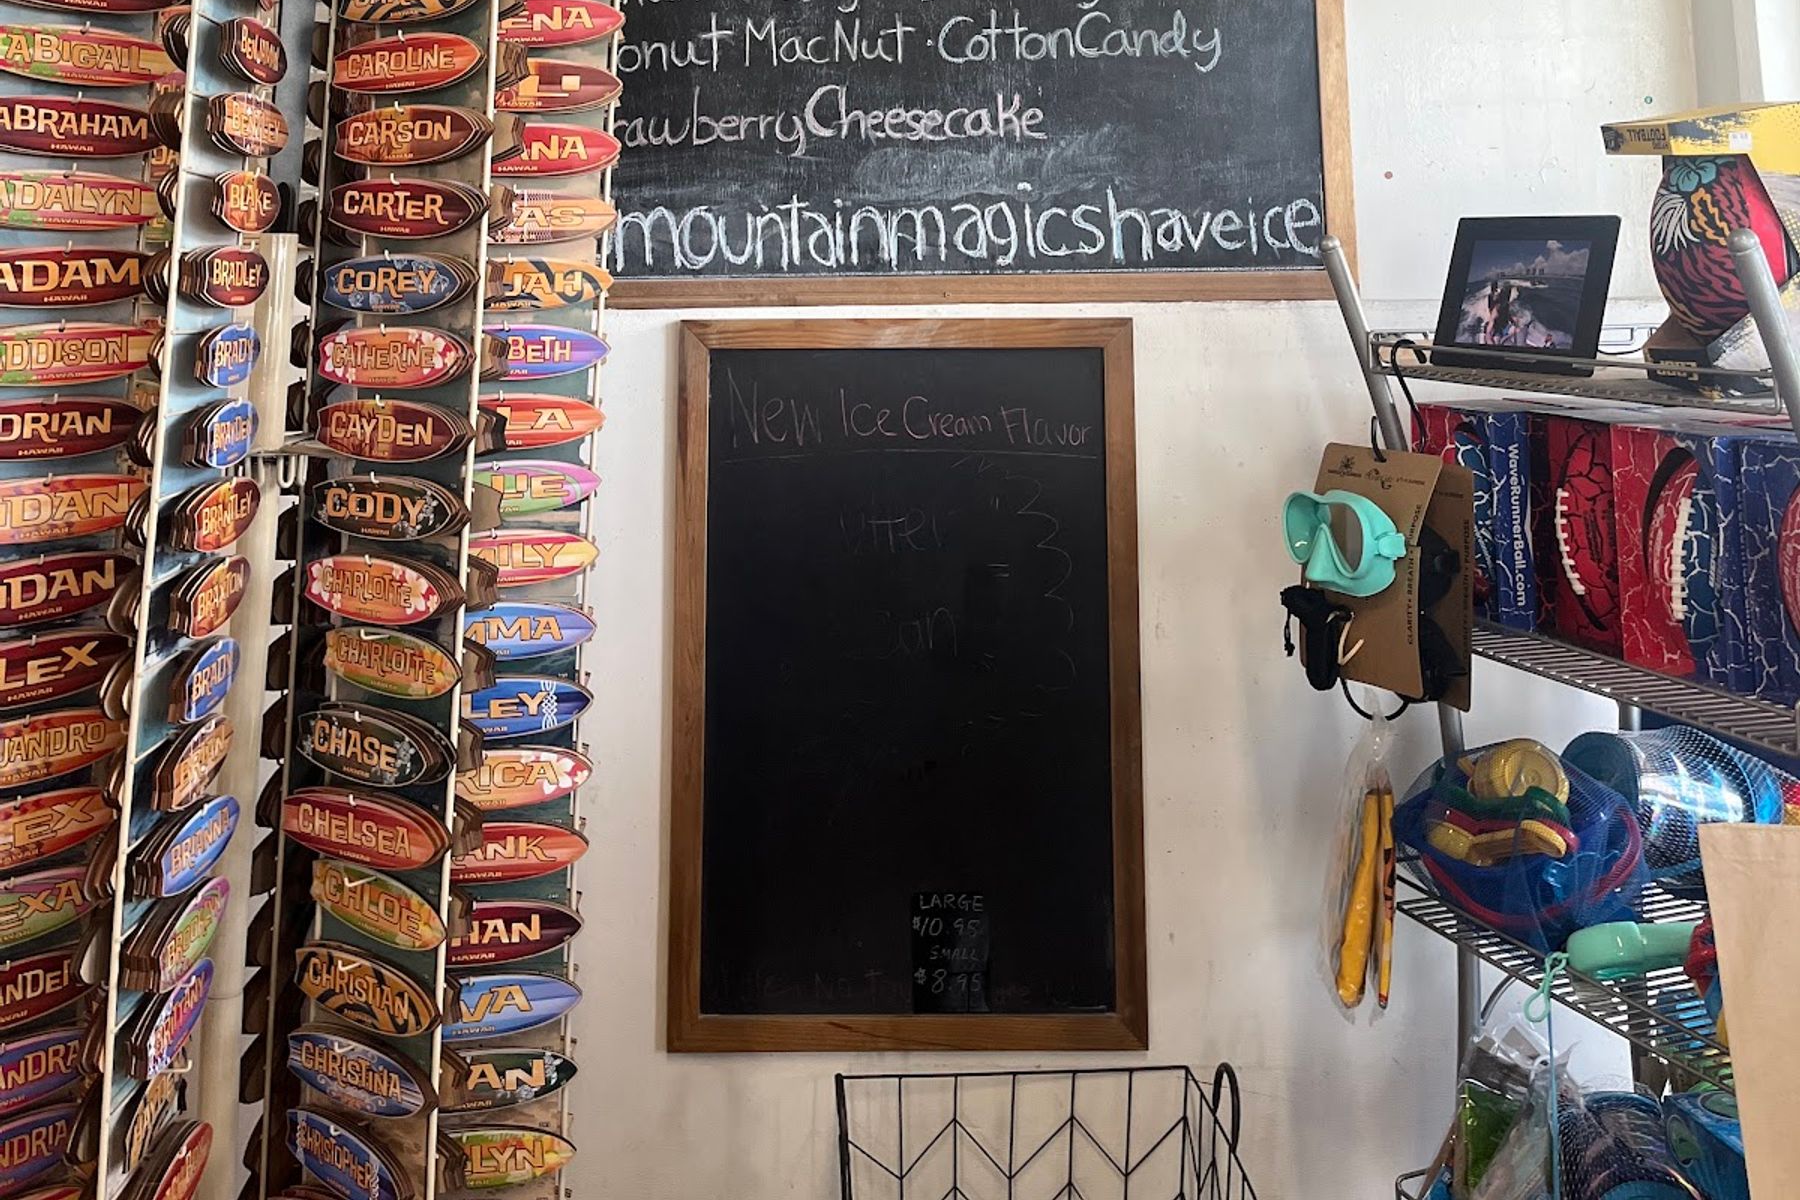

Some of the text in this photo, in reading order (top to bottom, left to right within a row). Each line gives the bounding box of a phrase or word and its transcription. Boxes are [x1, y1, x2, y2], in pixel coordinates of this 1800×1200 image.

[497, 5, 595, 34] ENA
[5, 33, 152, 74] ABIGAIL
[616, 8, 1224, 73] onut Mac Nut Cotton Candy
[346, 43, 455, 80] CAROLINE
[348, 115, 452, 149] CARSON
[612, 85, 1048, 158] rawberry Cheesecake
[229, 183, 274, 217] BLAKE
[343, 189, 449, 225] CARTER
[0, 258, 140, 294] ADAM
[211, 257, 263, 291] BRADLEY
[337, 266, 438, 299] COREY
[43, 294, 88, 303] HAWAII
[0, 333, 129, 372] DDISON
[214, 338, 255, 369] BRADY
[331, 339, 437, 373] CATHERINE
[726, 367, 1094, 448] New Ice Cream Flavor
[330, 410, 433, 448] CAYDEN
[202, 488, 254, 536] BRANTLEY
[325, 487, 427, 527] CODY
[1506, 442, 1527, 607] WaveRunnerBall.com
[197, 562, 245, 622] BRAXTON
[322, 566, 413, 610] CHARLOTTE
[1407, 559, 1415, 595] BREATH
[336, 634, 436, 686] CHARLOTTE
[312, 719, 399, 774] CHASE
[170, 804, 232, 879] BRIANNA
[298, 802, 413, 860] CHELSEA
[323, 866, 423, 941] CHLOE
[919, 893, 985, 912] LARGE
[929, 944, 981, 961] SMALL
[307, 956, 411, 1021] CHRISTIAN
[300, 1040, 402, 1102] CHRISTINA
[300, 1118, 377, 1187] CHRISTOPHER
[465, 1139, 545, 1175] LYN
